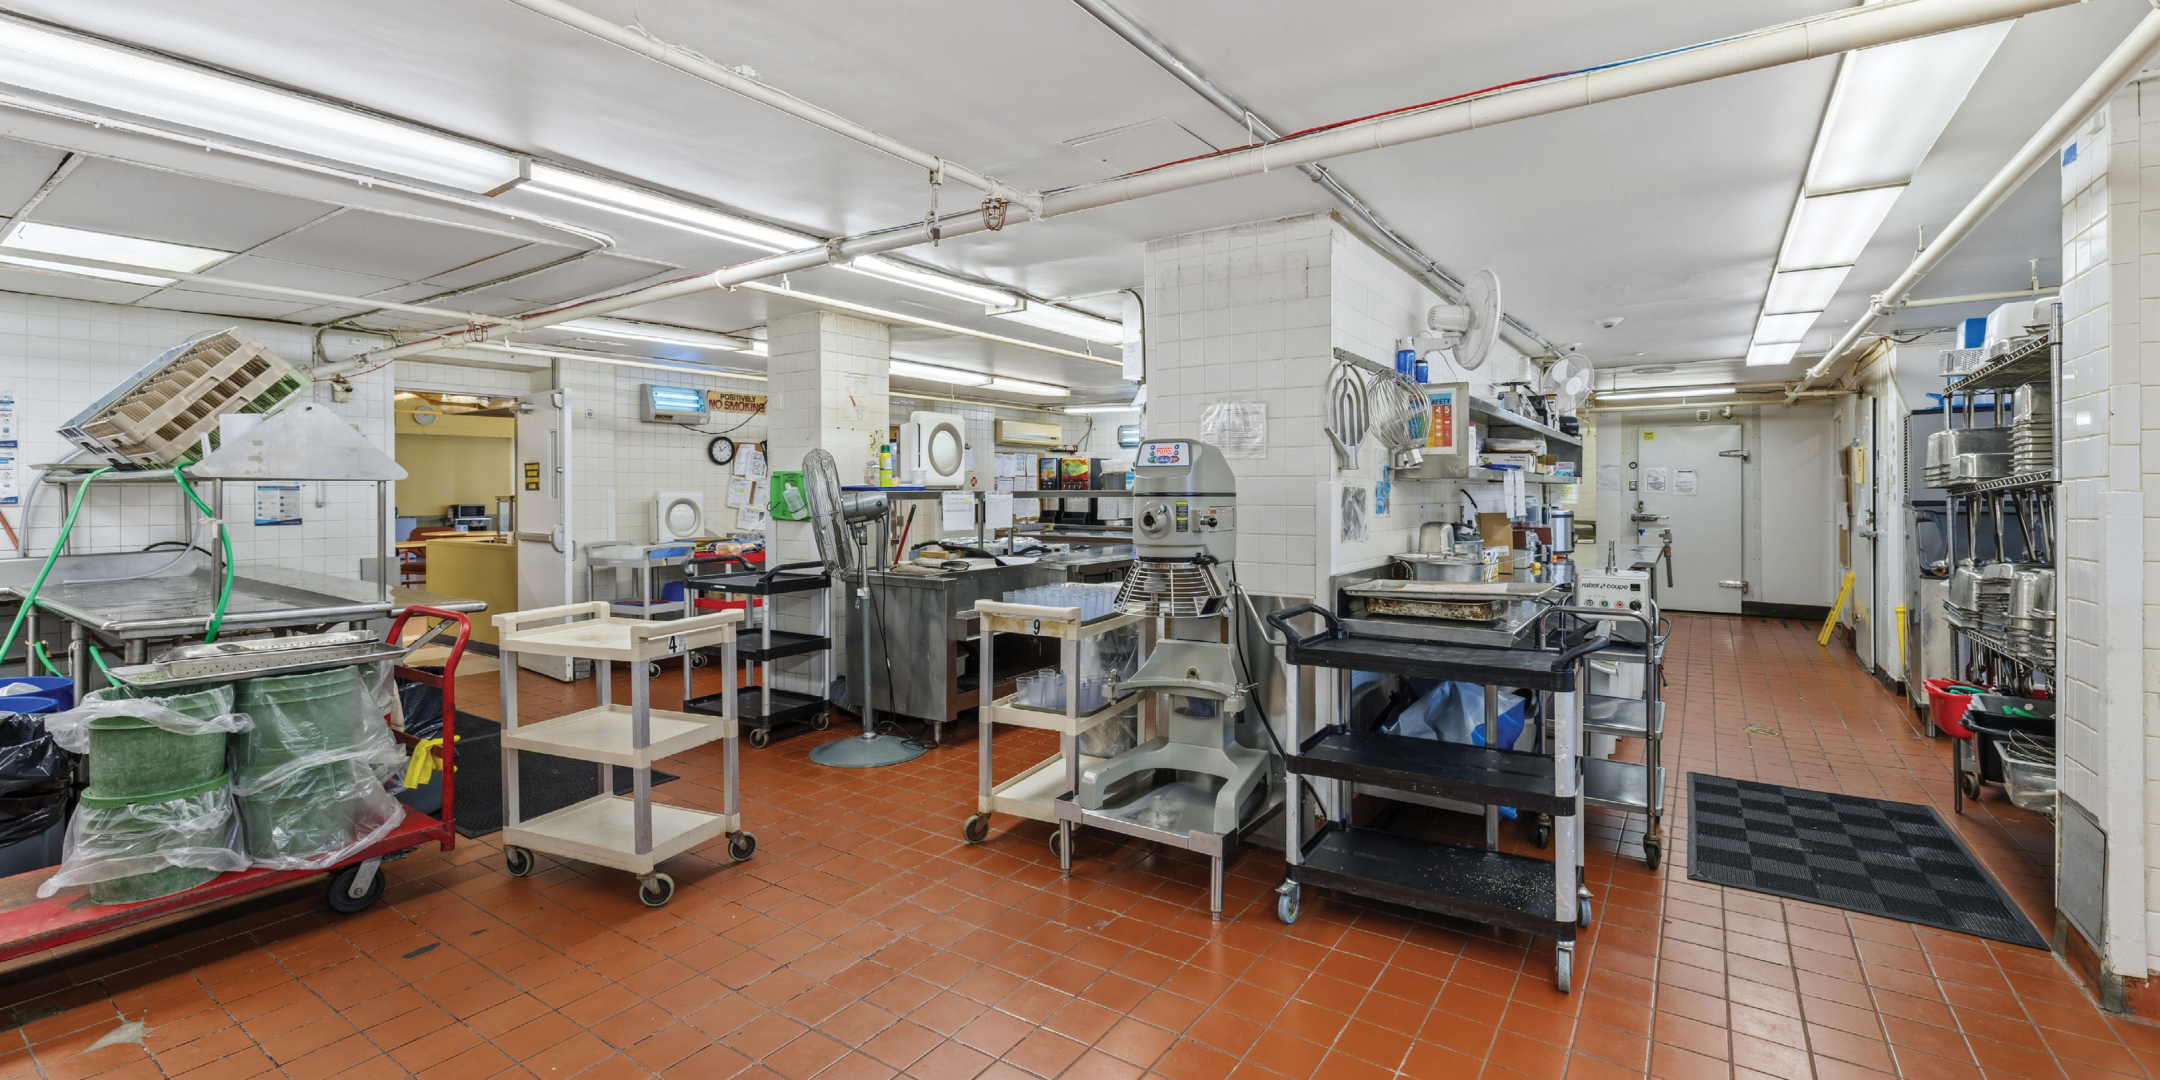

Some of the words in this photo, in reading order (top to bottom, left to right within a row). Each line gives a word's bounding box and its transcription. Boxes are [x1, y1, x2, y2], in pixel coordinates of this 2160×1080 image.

[720, 393, 757, 403] POSITIVELY
[709, 399, 723, 410] NO
[724, 401, 766, 414] SMOKING
[1606, 583, 1629, 591] coupe
[1033, 618, 1041, 636] 9
[668, 635, 678, 654] 4
